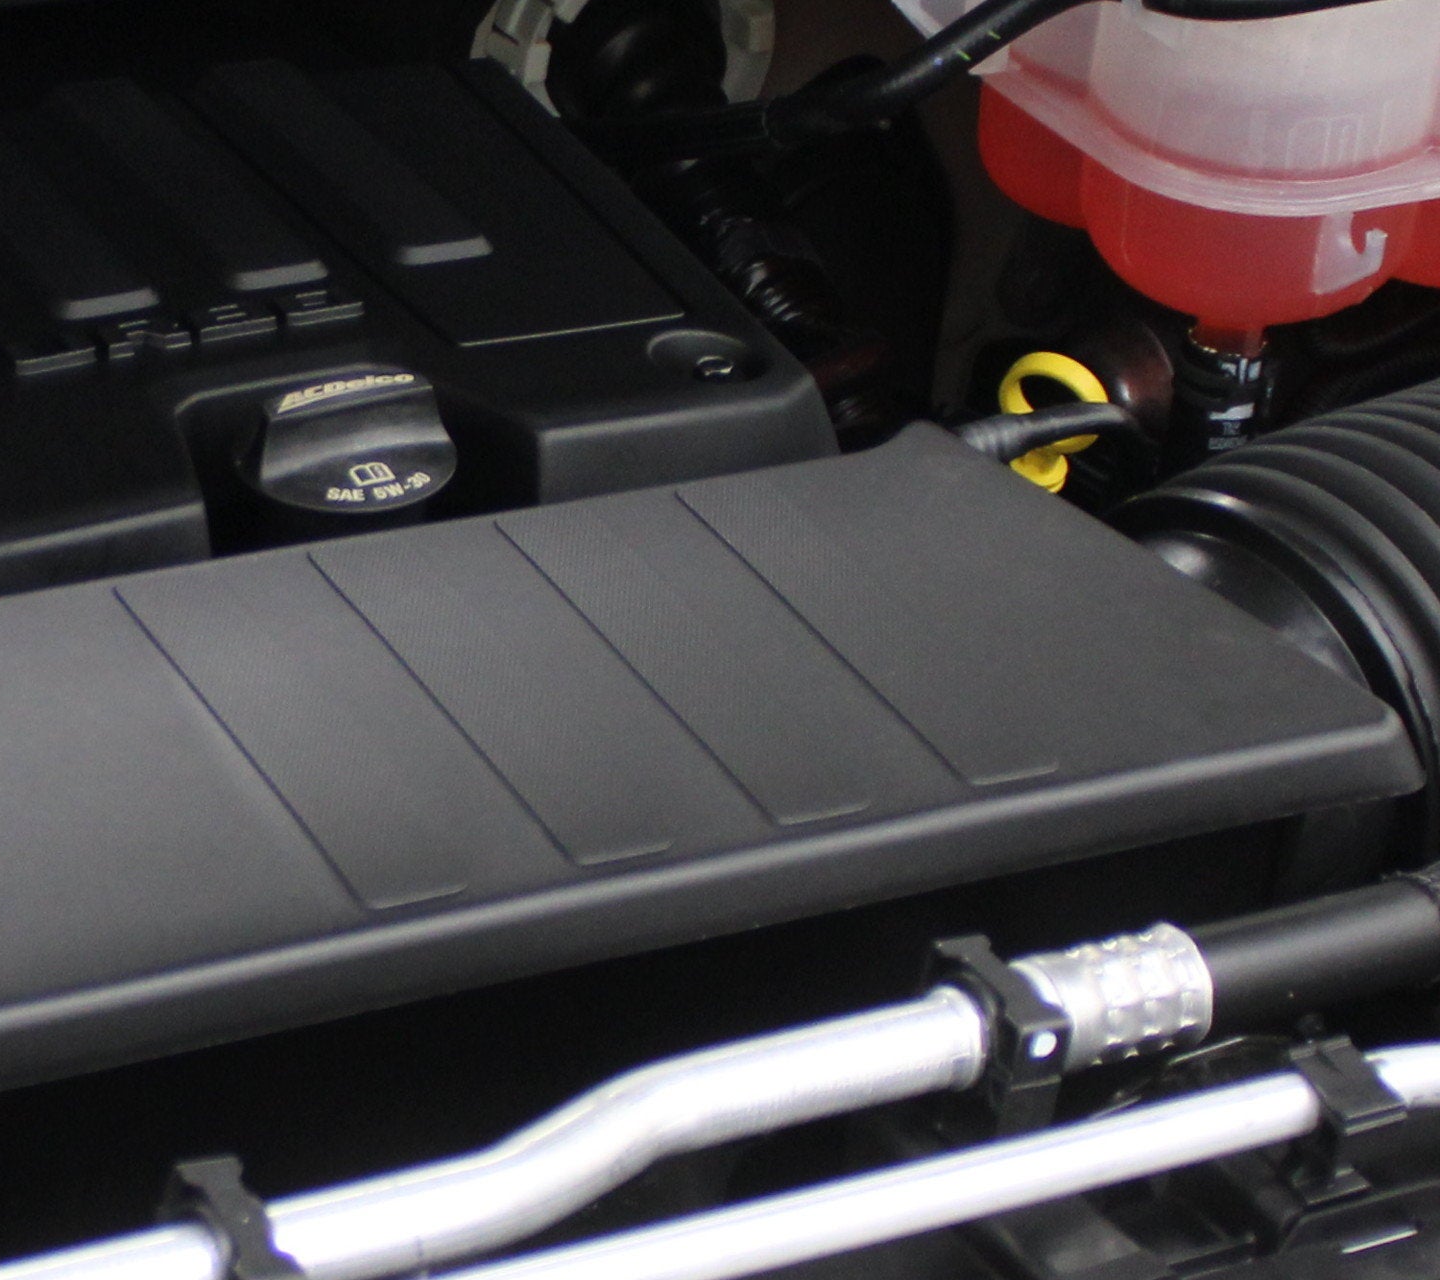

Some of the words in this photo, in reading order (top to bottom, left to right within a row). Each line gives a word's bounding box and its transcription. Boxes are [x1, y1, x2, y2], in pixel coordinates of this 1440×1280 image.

[277, 373, 415, 413] ACDelco
[326, 487, 365, 502] SAE
[372, 471, 431, 499] 5W-30
